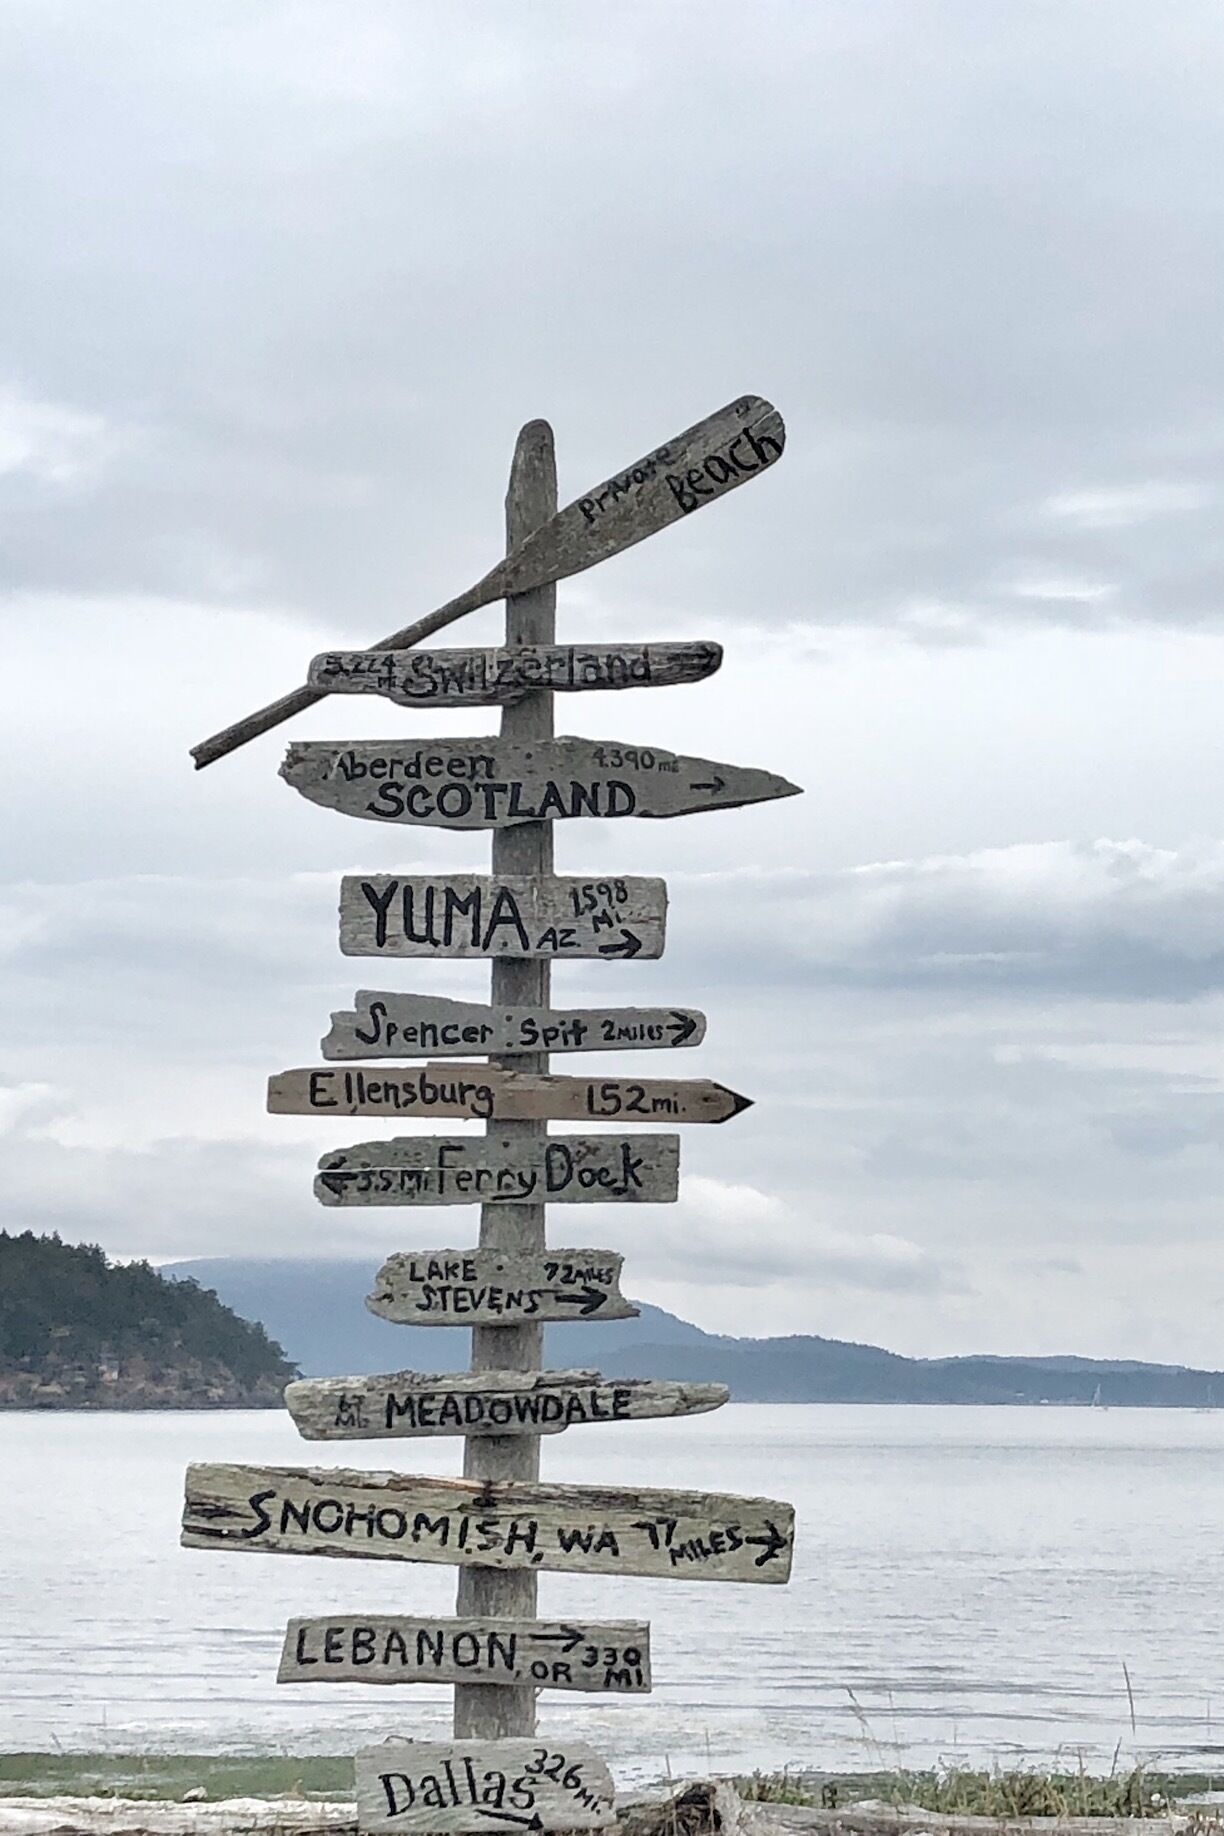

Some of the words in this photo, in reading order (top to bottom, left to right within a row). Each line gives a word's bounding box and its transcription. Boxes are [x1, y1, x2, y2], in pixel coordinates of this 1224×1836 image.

[324, 752, 496, 781] Aberdeen
[366, 780, 637, 820] SCOTLAND
[361, 880, 530, 951] YUMA
[569, 879, 628, 918] 1598
[355, 1001, 494, 1047] Spencer
[519, 1018, 588, 1047] Spit
[309, 1072, 494, 1117] Ellensburg
[438, 1146, 538, 1201] Ferry
[545, 1142, 645, 1193] Dock
[409, 1260, 479, 1282] LAKE
[415, 1284, 562, 1314] STEVENS
[386, 1389, 632, 1429] MEADOWDALE
[558, 1524, 619, 1556] WA
[668, 1526, 744, 1566] MILES
[531, 1660, 572, 1683] OR
[378, 1756, 536, 1817] Dallas
[525, 1748, 584, 1790] 326
